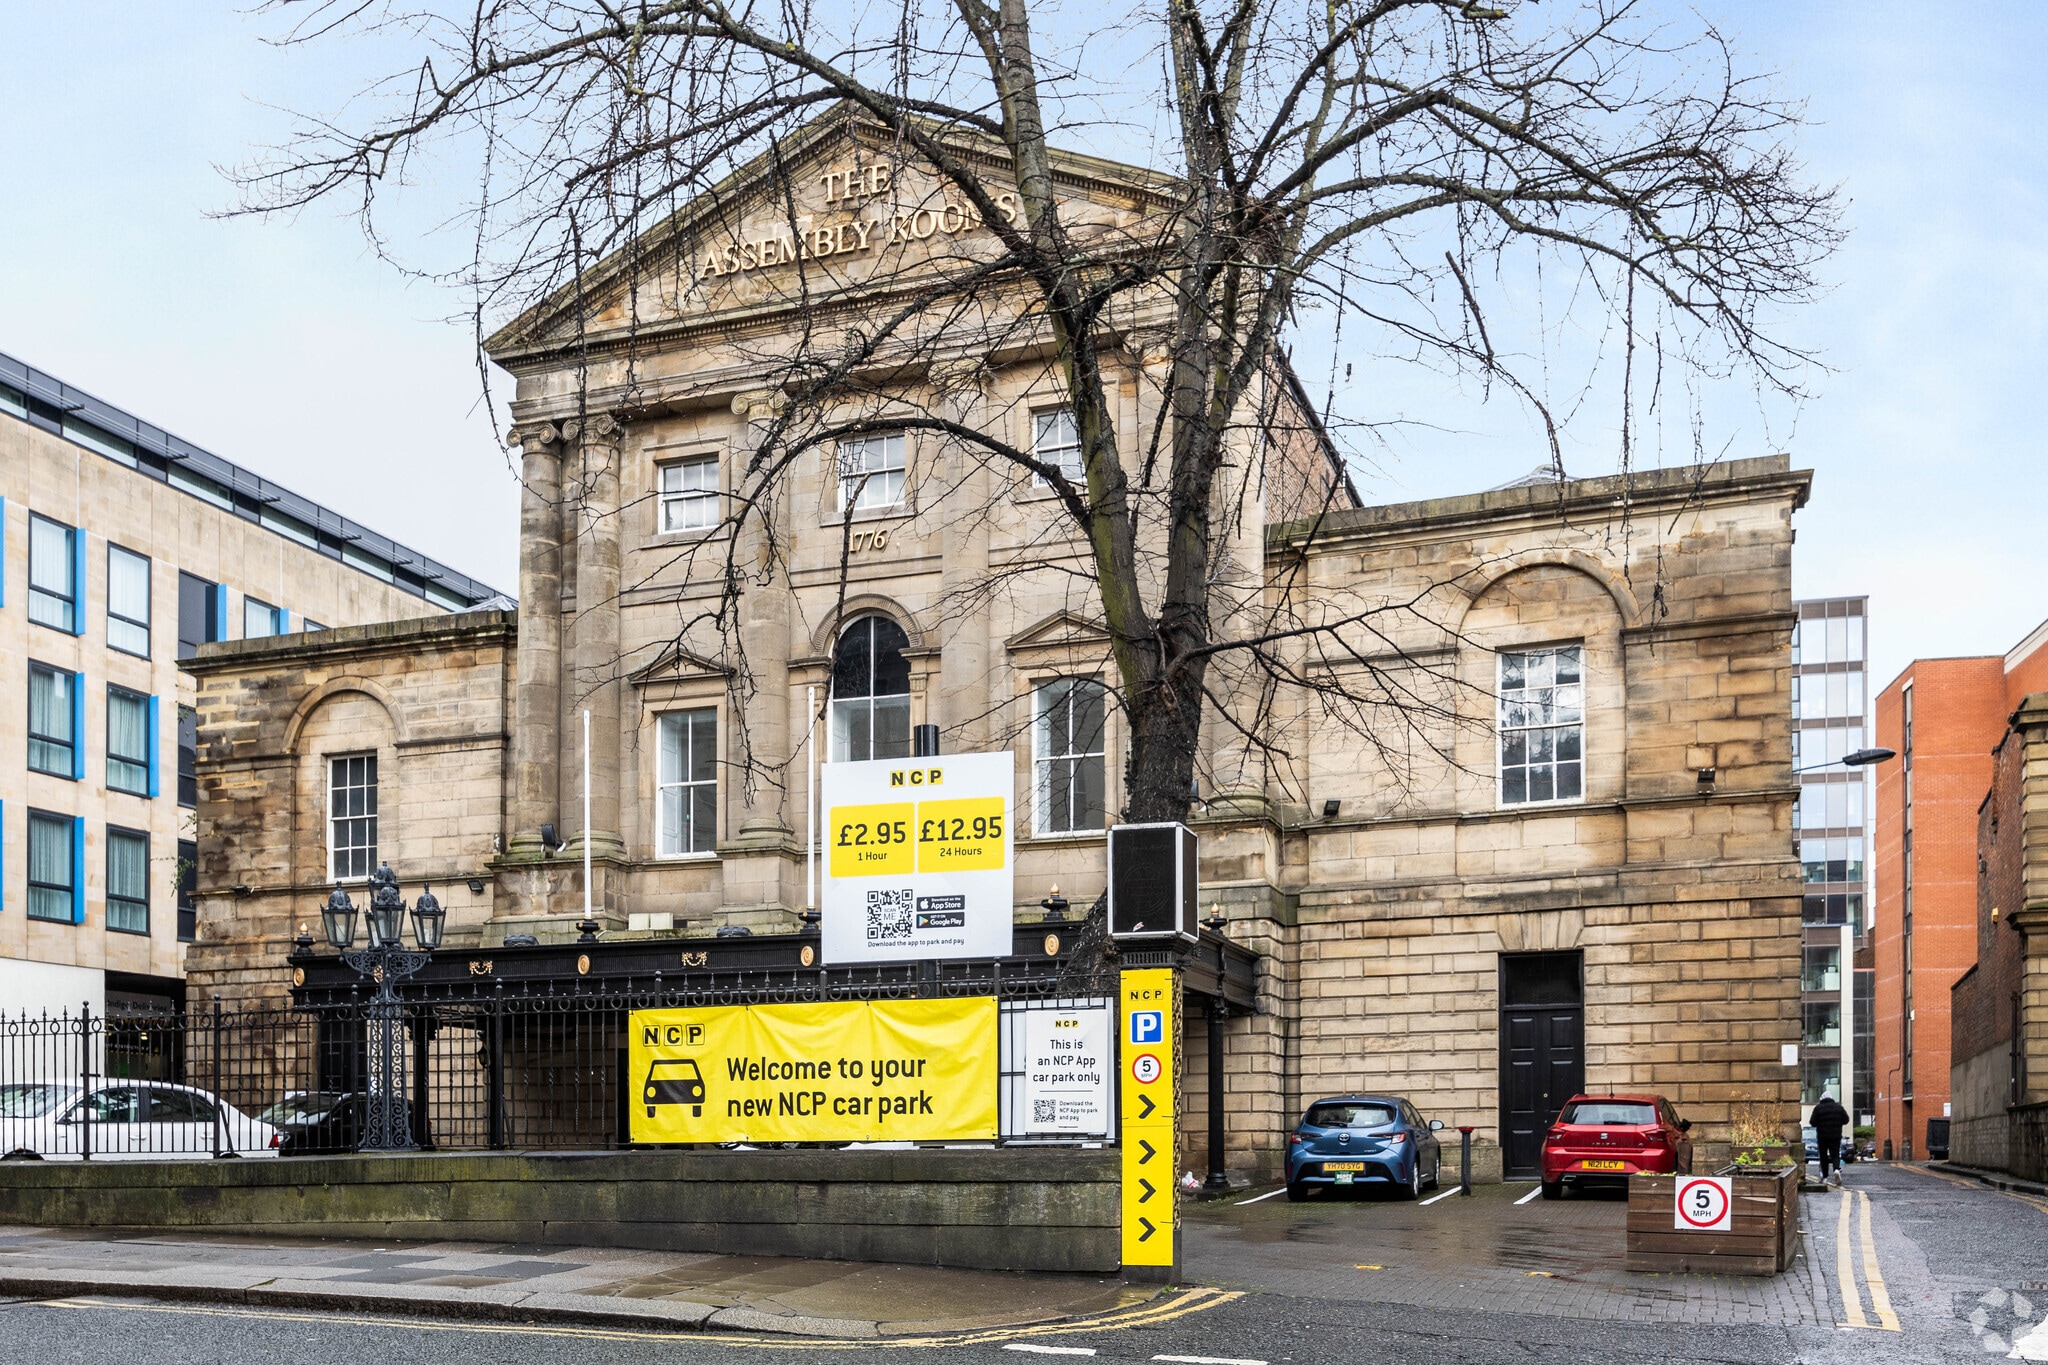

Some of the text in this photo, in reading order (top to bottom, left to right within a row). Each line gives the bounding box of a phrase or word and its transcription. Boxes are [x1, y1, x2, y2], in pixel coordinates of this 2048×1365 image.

[820, 164, 891, 204] THE
[700, 218, 878, 280] ASSEMBLY
[849, 529, 887, 552] 1776
[890, 769, 942, 786] NCP
[837, 821, 906, 847] £2.95
[919, 815, 1002, 843] £12.95
[858, 851, 888, 861] 1 Hour
[940, 847, 982, 857] 24 Hours
[931, 901, 961, 910] App Store
[930, 918, 962, 926] Google Play
[1130, 990, 1162, 1000] NCP
[1055, 1020, 1078, 1028] NCP
[1136, 1013, 1157, 1042] P
[644, 1026, 702, 1044] NCP
[1050, 1039, 1083, 1049] This is
[1037, 1055, 1096, 1068] an NCP App
[1142, 1060, 1151, 1072] 5
[727, 1056, 926, 1087] Welcome to your
[1032, 1071, 1100, 1085] car park only
[727, 1090, 934, 1123] new NCP car park
[1696, 1190, 1710, 1208] 5
